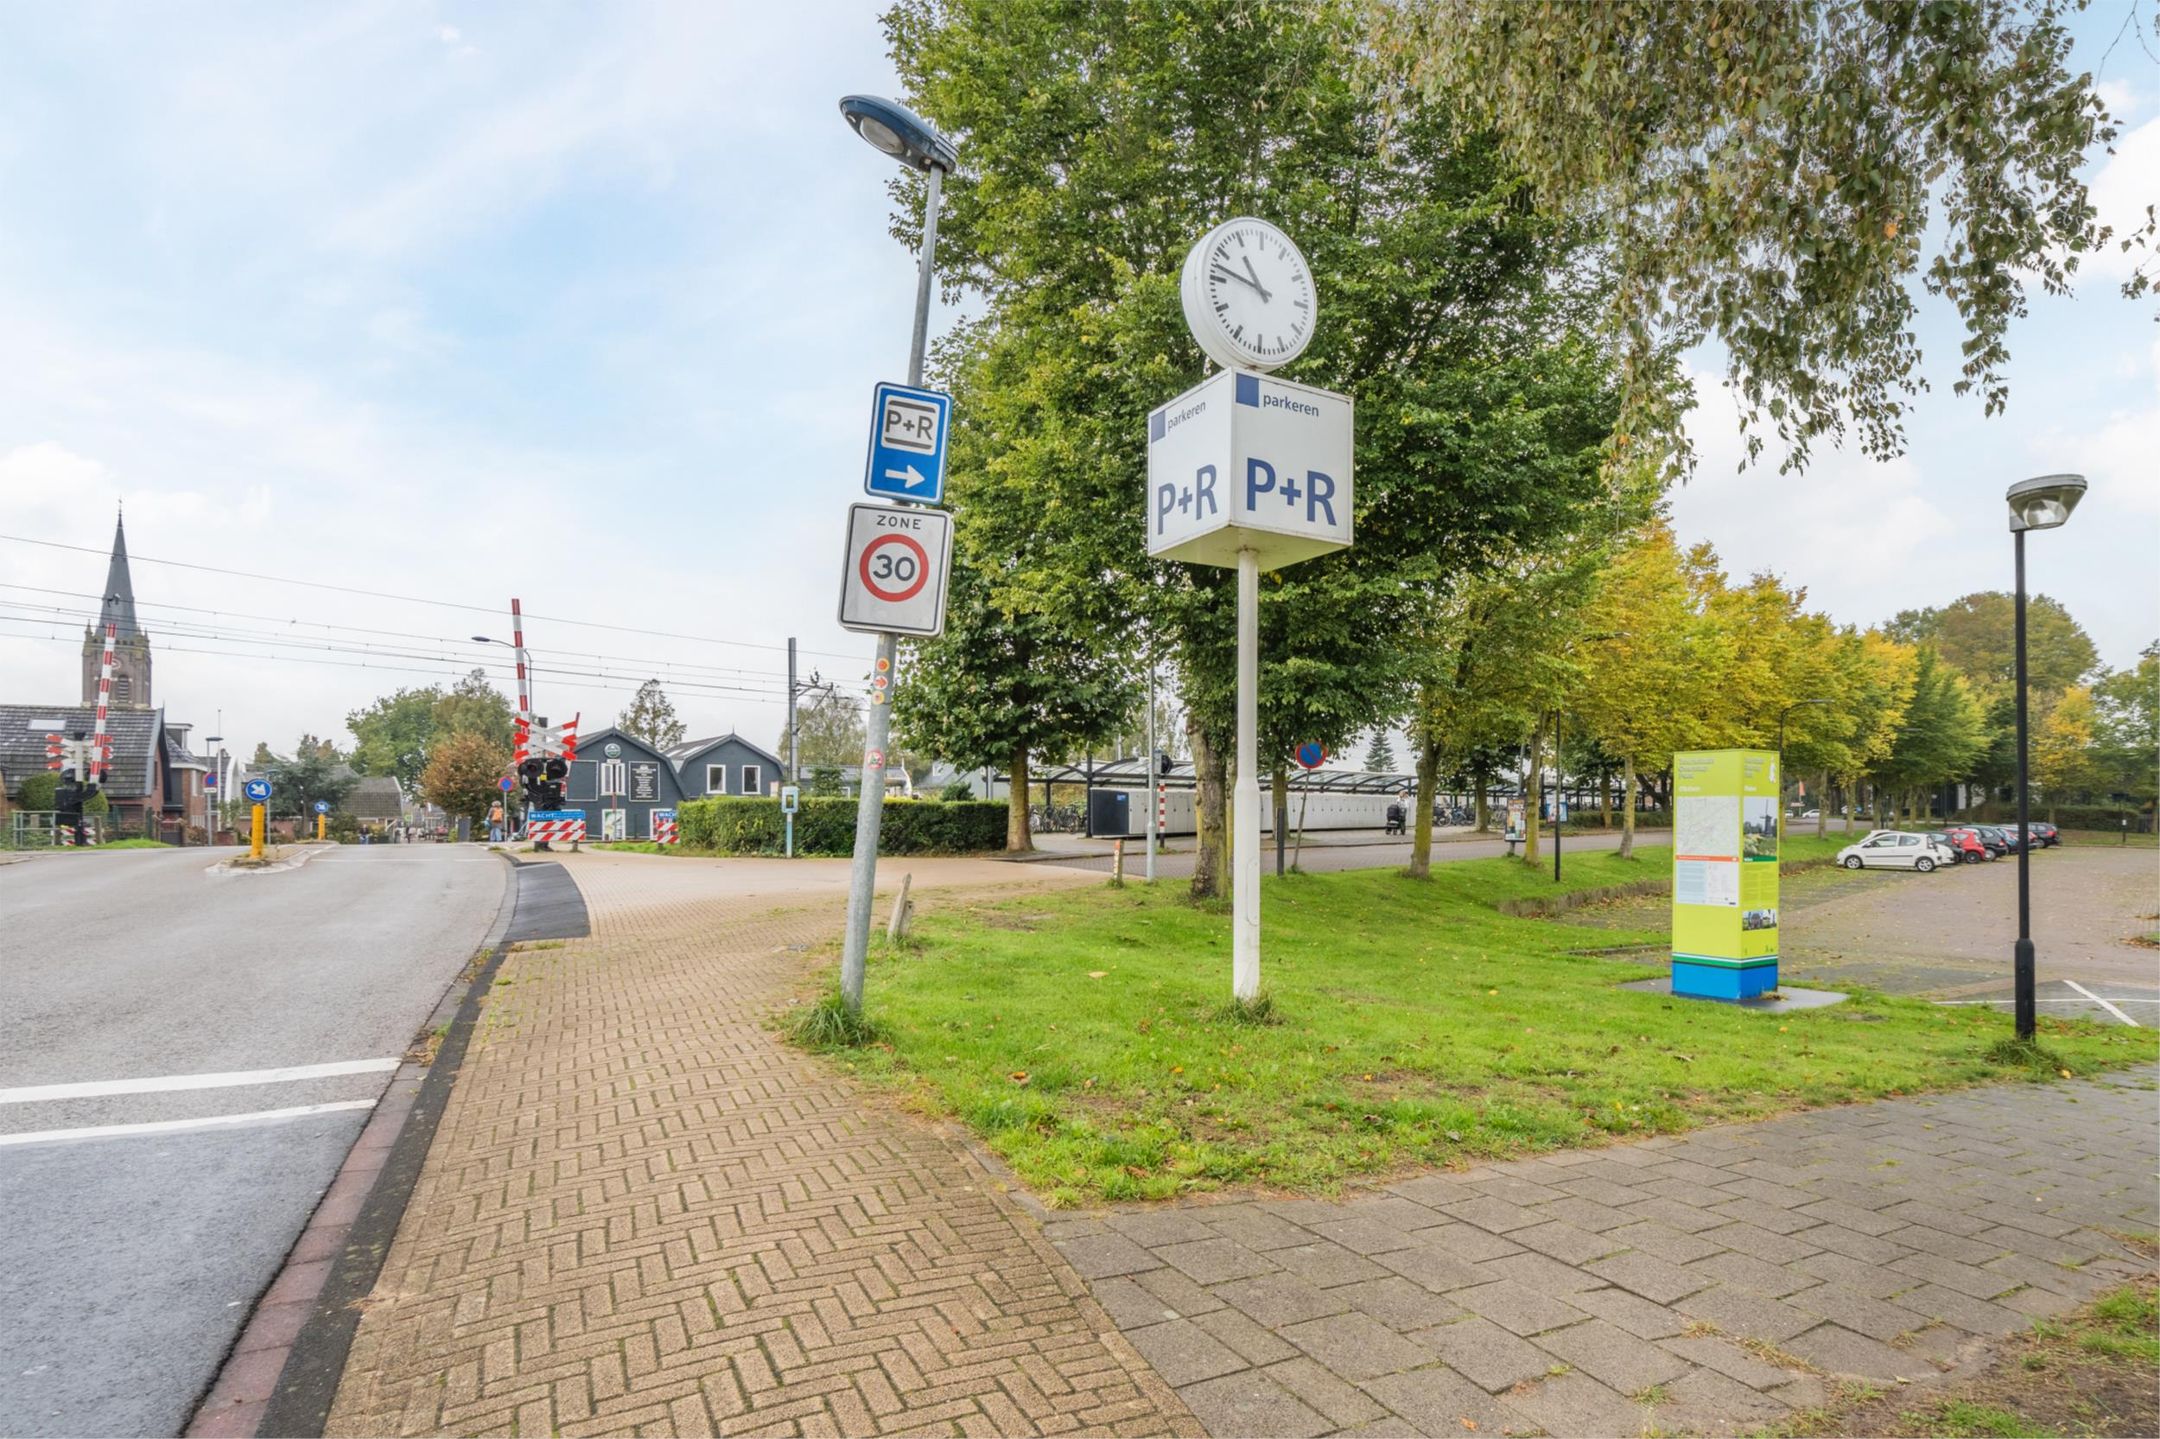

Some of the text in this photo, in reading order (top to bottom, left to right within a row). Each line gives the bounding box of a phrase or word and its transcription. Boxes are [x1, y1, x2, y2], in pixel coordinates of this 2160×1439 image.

[1167, 400, 1207, 432] parkeren
[1263, 393, 1319, 418] parkeren
[884, 409, 934, 441] P+R
[1157, 463, 1218, 536] P+R
[1246, 457, 1337, 527] P+R
[876, 514, 922, 530] ZONE
[872, 553, 916, 582] 30
